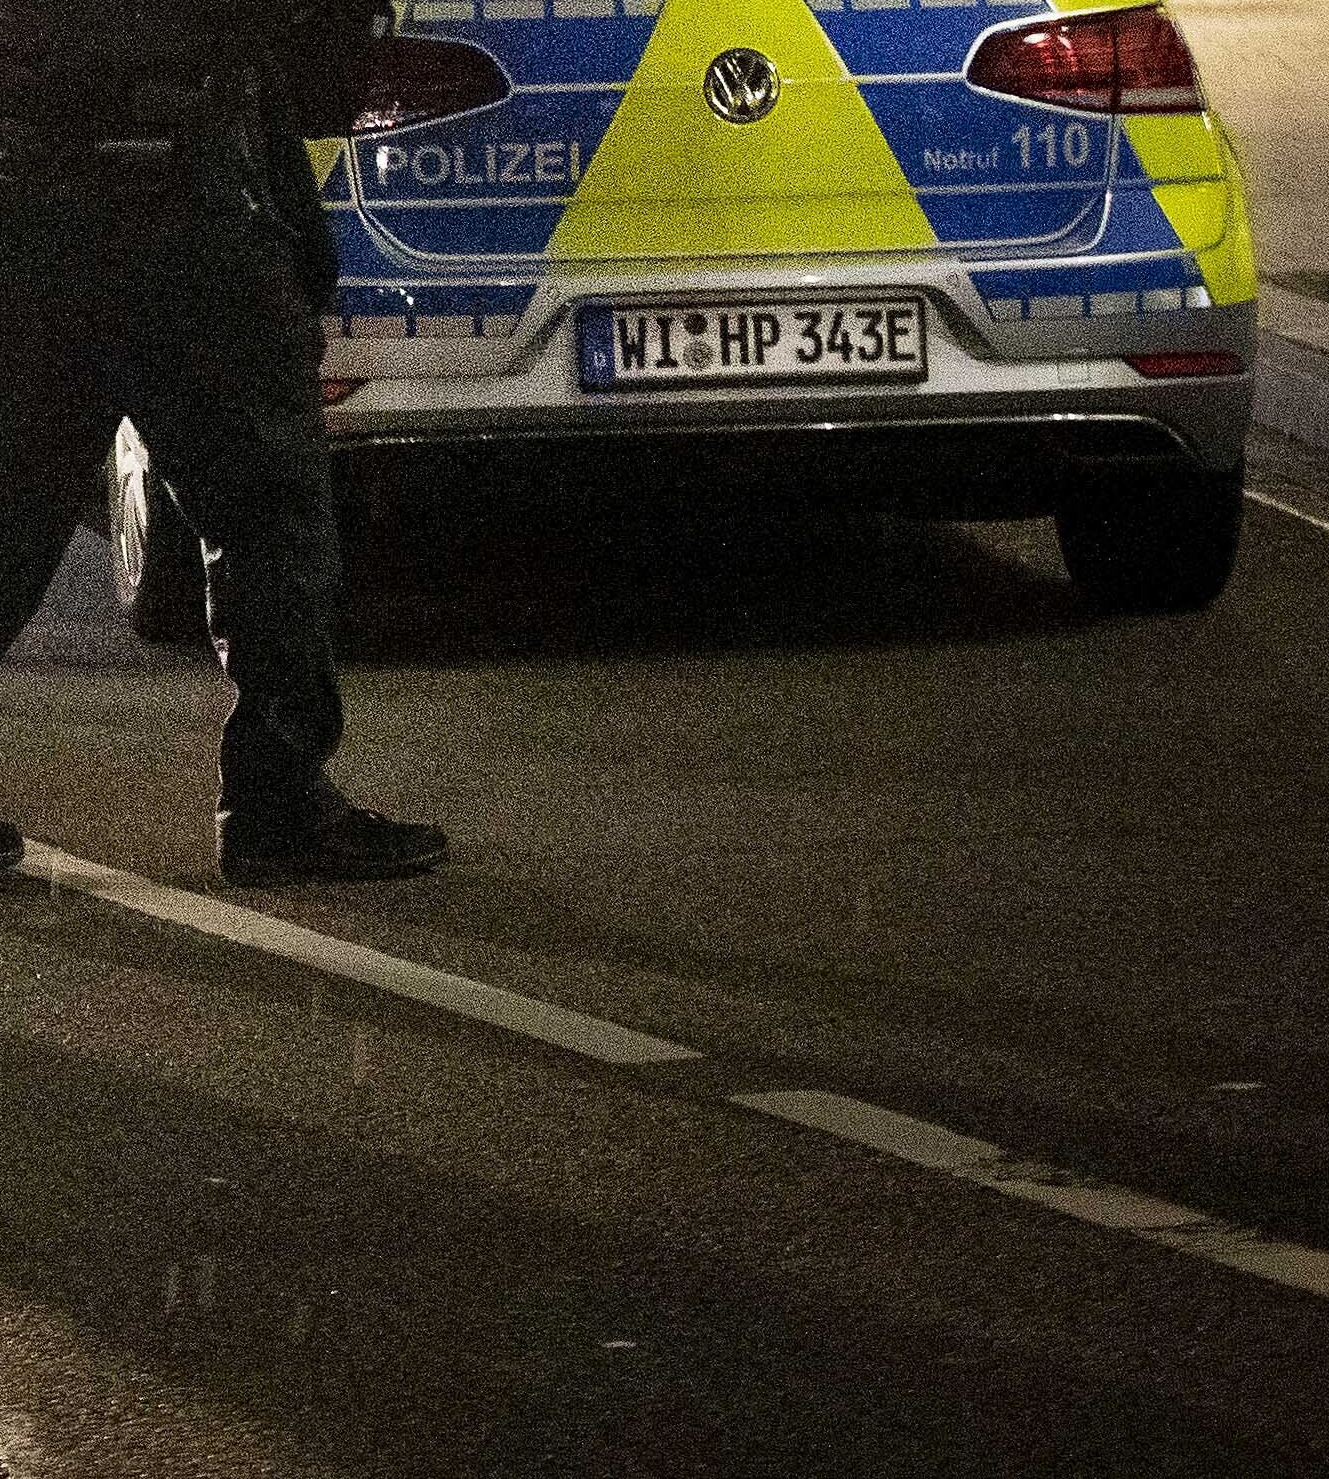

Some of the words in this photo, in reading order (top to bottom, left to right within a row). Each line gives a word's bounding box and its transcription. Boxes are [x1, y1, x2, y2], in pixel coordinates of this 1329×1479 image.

[375, 140, 582, 186] POLIZEI
[923, 145, 1001, 170] Notruf
[1011, 122, 1090, 170] 110
[618, 316, 679, 370] WI
[719, 312, 781, 366] HP
[794, 308, 917, 364] 343E
